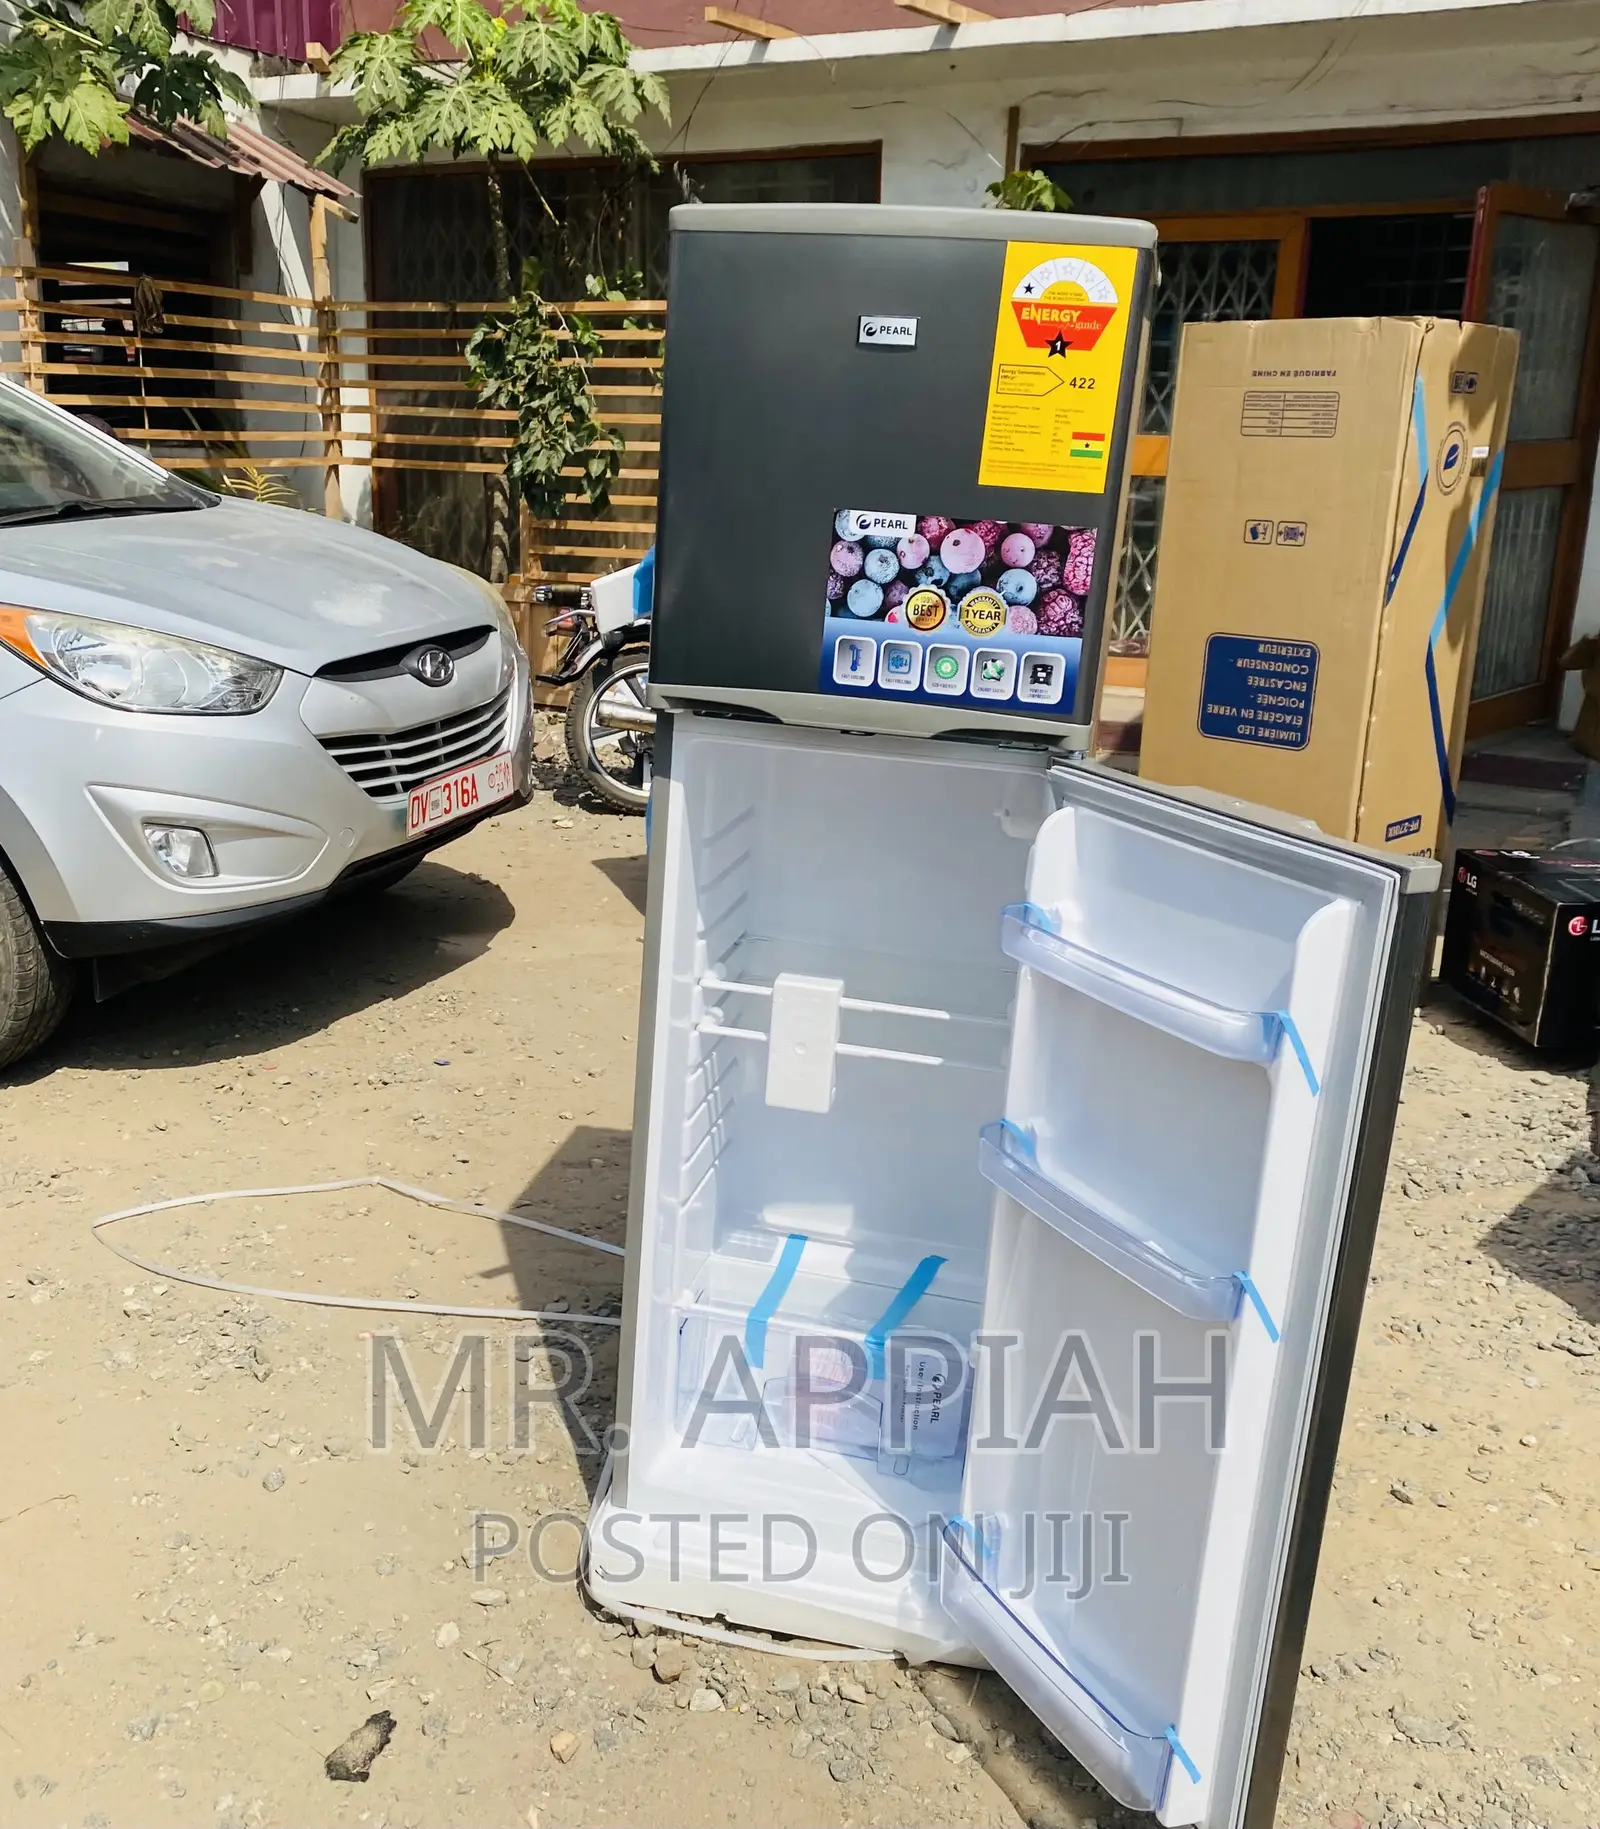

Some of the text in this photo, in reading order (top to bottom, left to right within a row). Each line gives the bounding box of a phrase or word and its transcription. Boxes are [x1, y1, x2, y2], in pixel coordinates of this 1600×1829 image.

[1021, 303, 1082, 325] ENERGY
[879, 325, 913, 336] PEARL
[1055, 340, 1062, 351] 1
[1293, 369, 1337, 380] FABRIQUÉ
[1069, 376, 1096, 390] 422
[873, 517, 909, 531] PEARL
[968, 596, 1000, 609] WARRANTY
[913, 604, 940, 617] BEST
[964, 608, 1001, 621] 1 YEAR
[966, 620, 999, 634] WARRANTY
[1257, 643, 1311, 659] EXTÉRIEUR
[1236, 658, 1309, 675] CONDENSEUR
[1247, 675, 1307, 692] ENCASTRÉE
[1256, 694, 1305, 709] POIGNÉE
[1206, 703, 1238, 717] VERRE
[1240, 708, 1255, 719] EN
[1237, 724, 1301, 742] LUMIÈRE LED
[442, 773, 479, 815] 316A
[1466, 872, 1478, 889] LG
[912, 1384, 924, 1431] Instruction
[930, 1391, 942, 1424] PEARL
